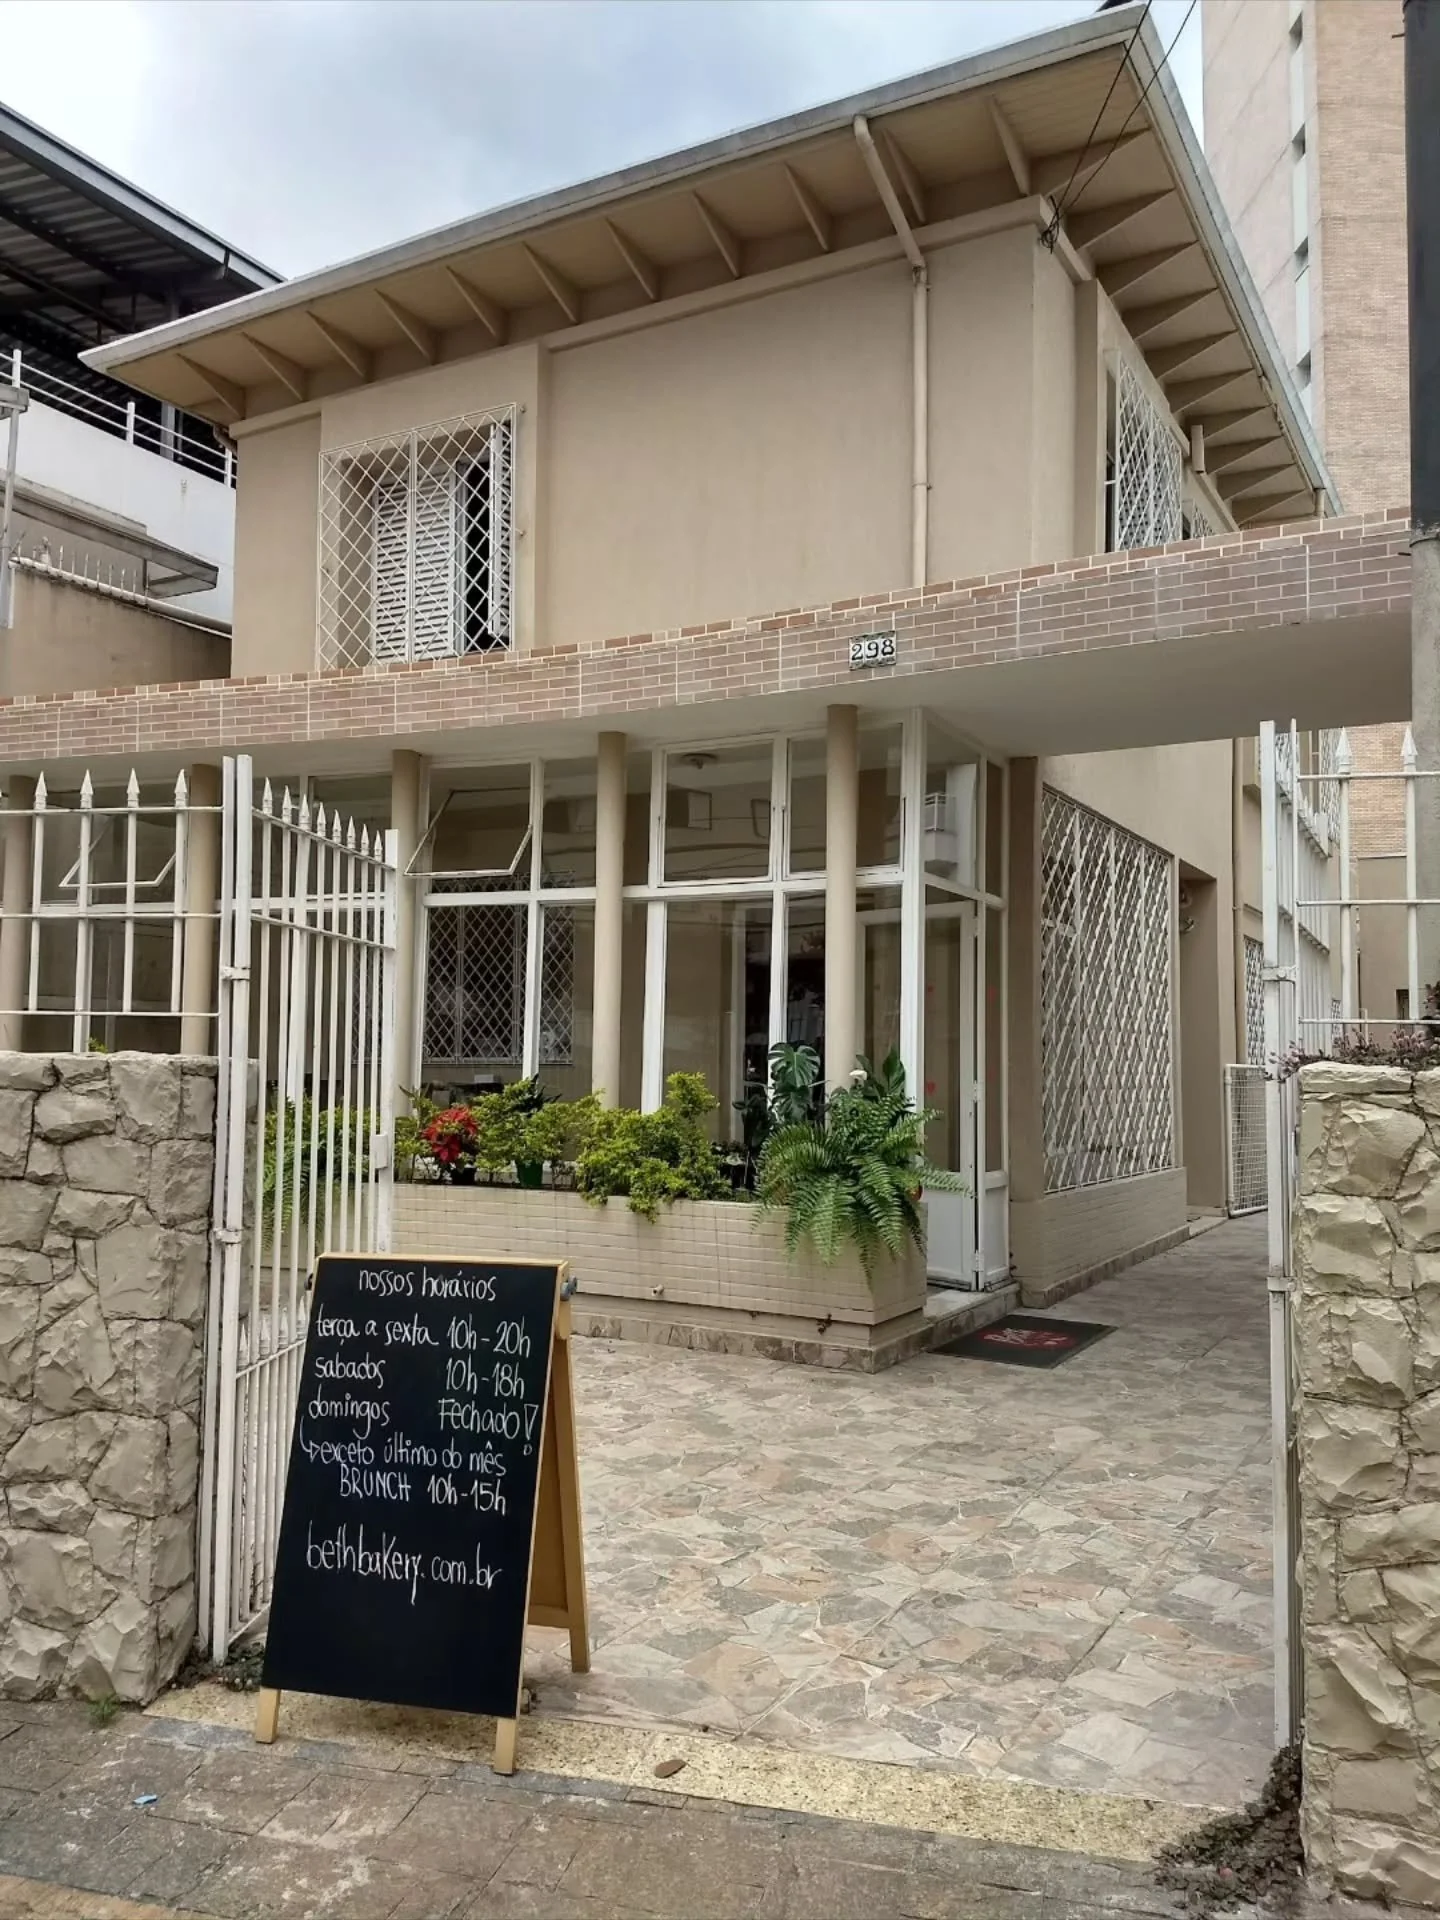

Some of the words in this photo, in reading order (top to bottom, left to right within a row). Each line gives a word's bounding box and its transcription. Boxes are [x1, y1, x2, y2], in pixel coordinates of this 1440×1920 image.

[851, 638, 896, 661] 298
[359, 1269, 414, 1297] nossos
[422, 1267, 497, 1301] horários
[315, 1304, 361, 1346] terça
[365, 1318, 378, 1336] a
[385, 1314, 439, 1347] sexta
[315, 1353, 386, 1389] sabados
[309, 1384, 390, 1440] domingos
[319, 1440, 374, 1466] exceto
[384, 1432, 437, 1466] último
[442, 1438, 463, 1468] do
[469, 1441, 507, 1476] mês
[340, 1464, 412, 1502] BRUNCH
